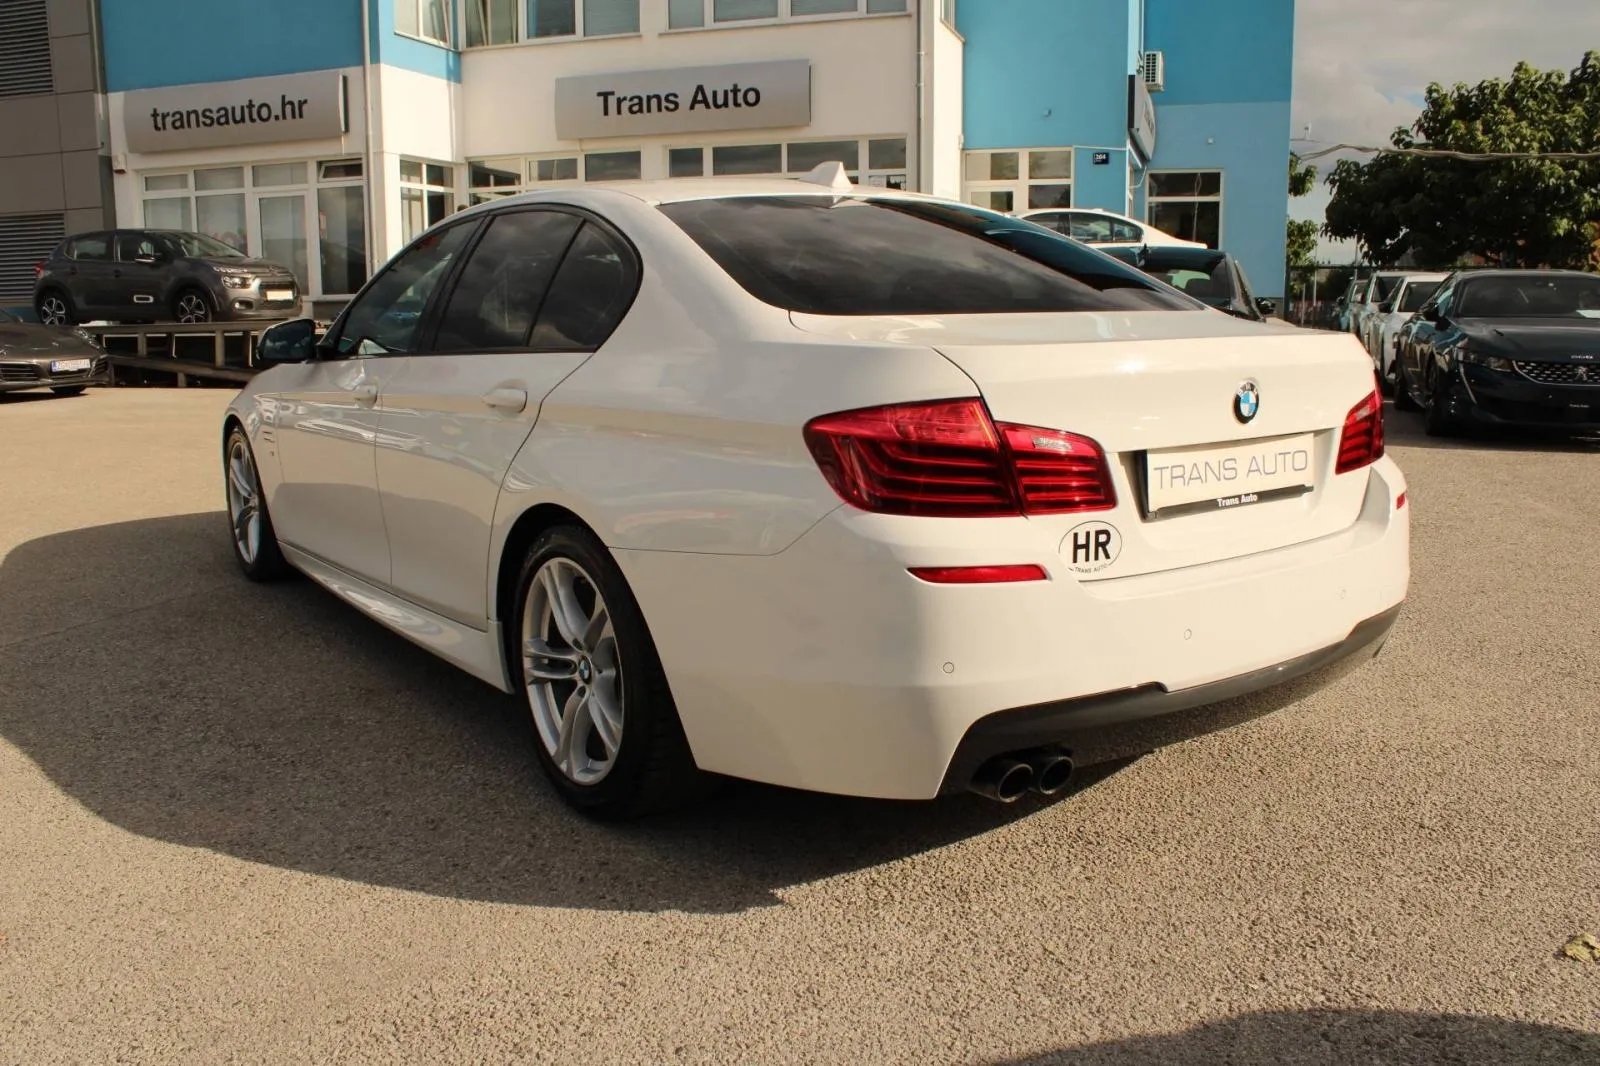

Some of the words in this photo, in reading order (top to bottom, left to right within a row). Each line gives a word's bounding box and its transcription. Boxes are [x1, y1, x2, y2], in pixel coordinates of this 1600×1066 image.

[150, 94, 309, 132] transauto.hr
[596, 91, 680, 116] Trans
[688, 83, 761, 111] Auto
[1153, 457, 1238, 490] TRANS
[1246, 450, 1308, 479] AUTO
[1216, 497, 1240, 507] Trans
[1240, 493, 1258, 503] Auto
[1072, 529, 1112, 564] HR
